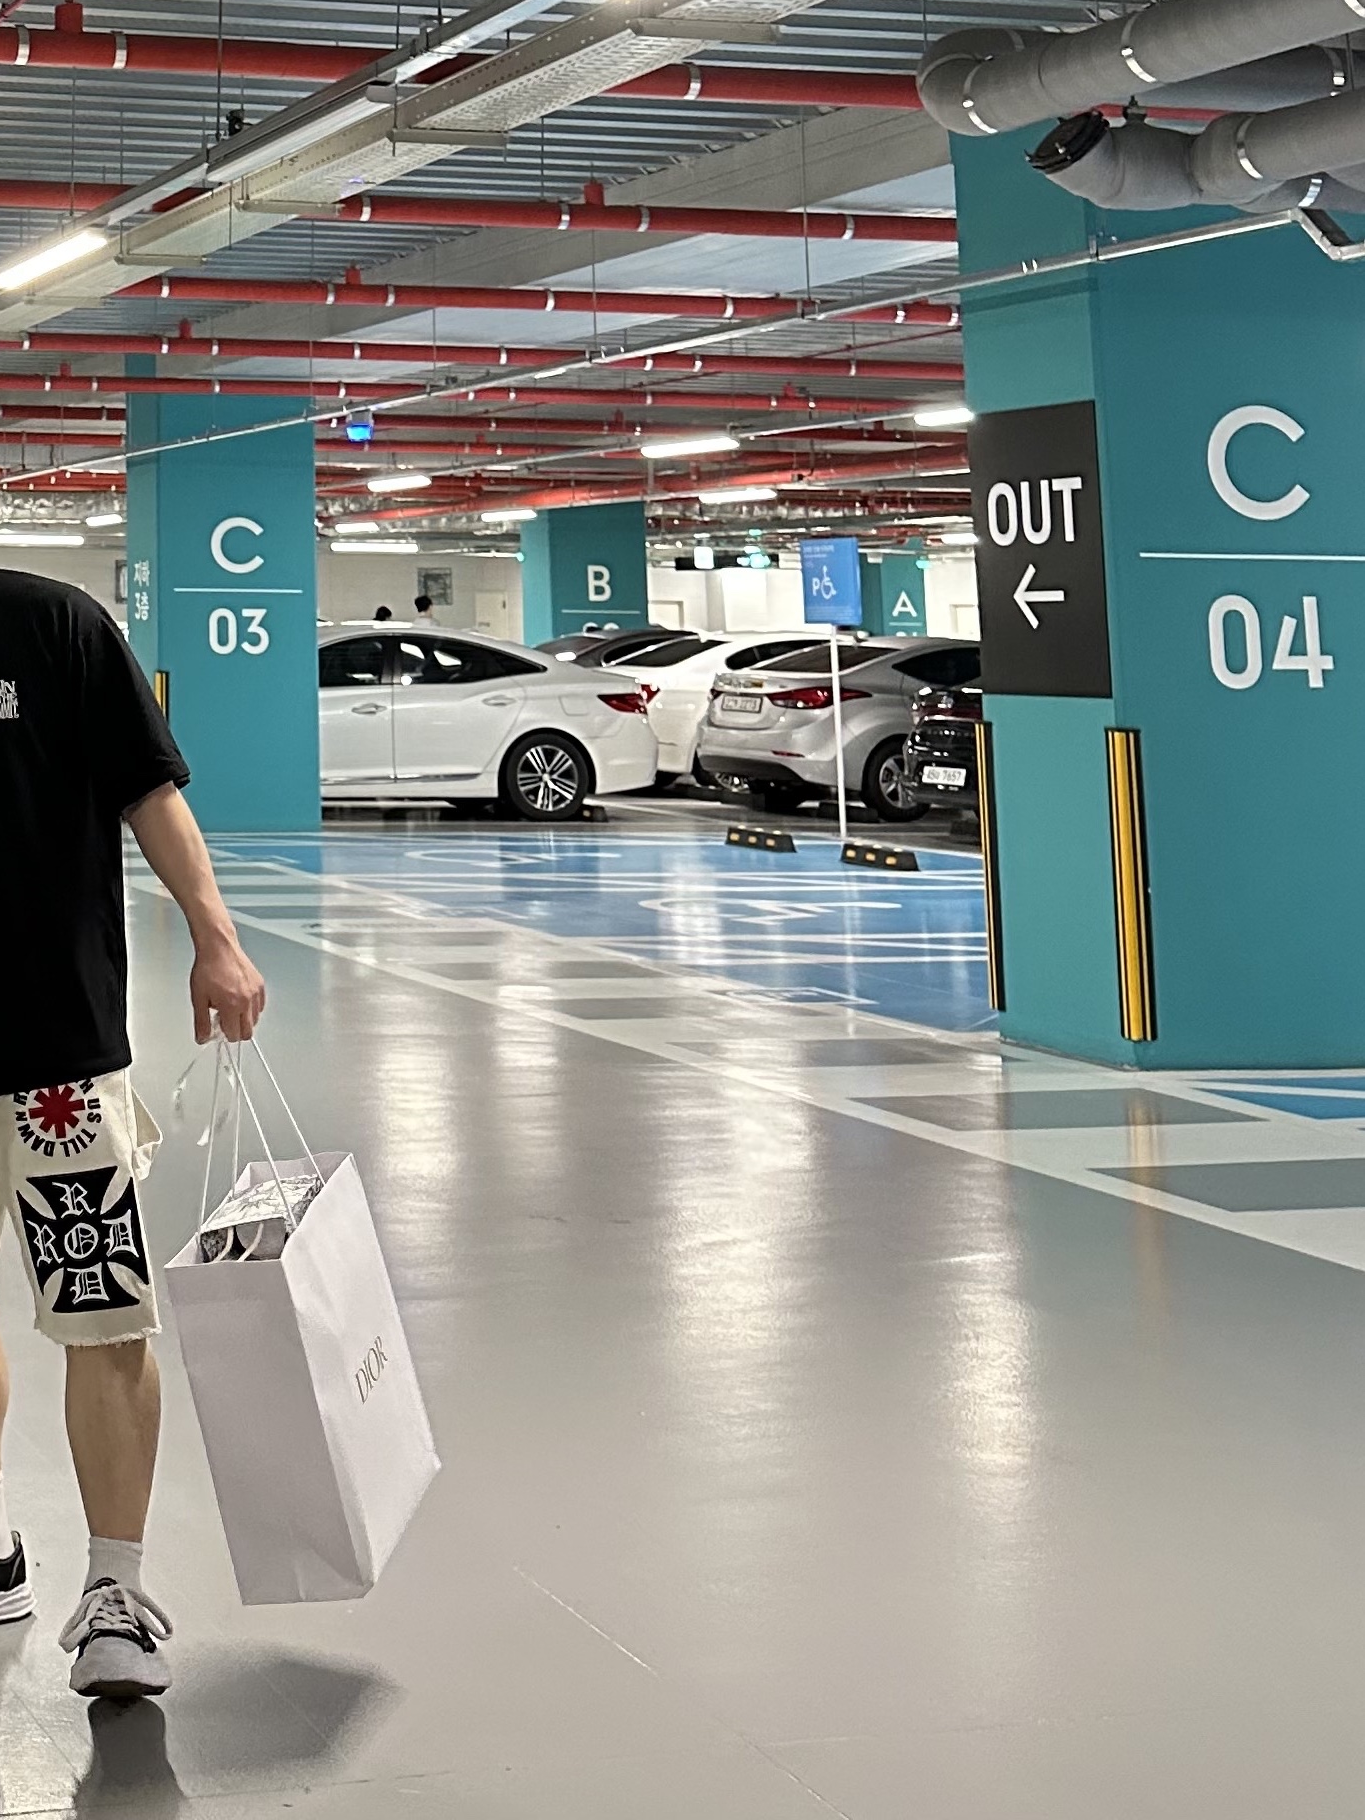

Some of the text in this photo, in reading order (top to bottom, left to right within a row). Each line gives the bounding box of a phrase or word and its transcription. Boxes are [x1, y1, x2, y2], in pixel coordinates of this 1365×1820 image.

[1207, 405, 1311, 521] C
[987, 476, 1082, 547] OUT
[210, 516, 265, 574] C
[587, 564, 612, 602] B
[892, 589, 918, 617] A
[208, 607, 270, 656] 03
[1208, 594, 1335, 690] 04
[14, 1110, 57, 1157] DAWN
[59, 1128, 97, 1158] TILL
[51, 1182, 96, 1219] R
[66, 1261, 110, 1305] D
[355, 1334, 389, 1405] DIOR
